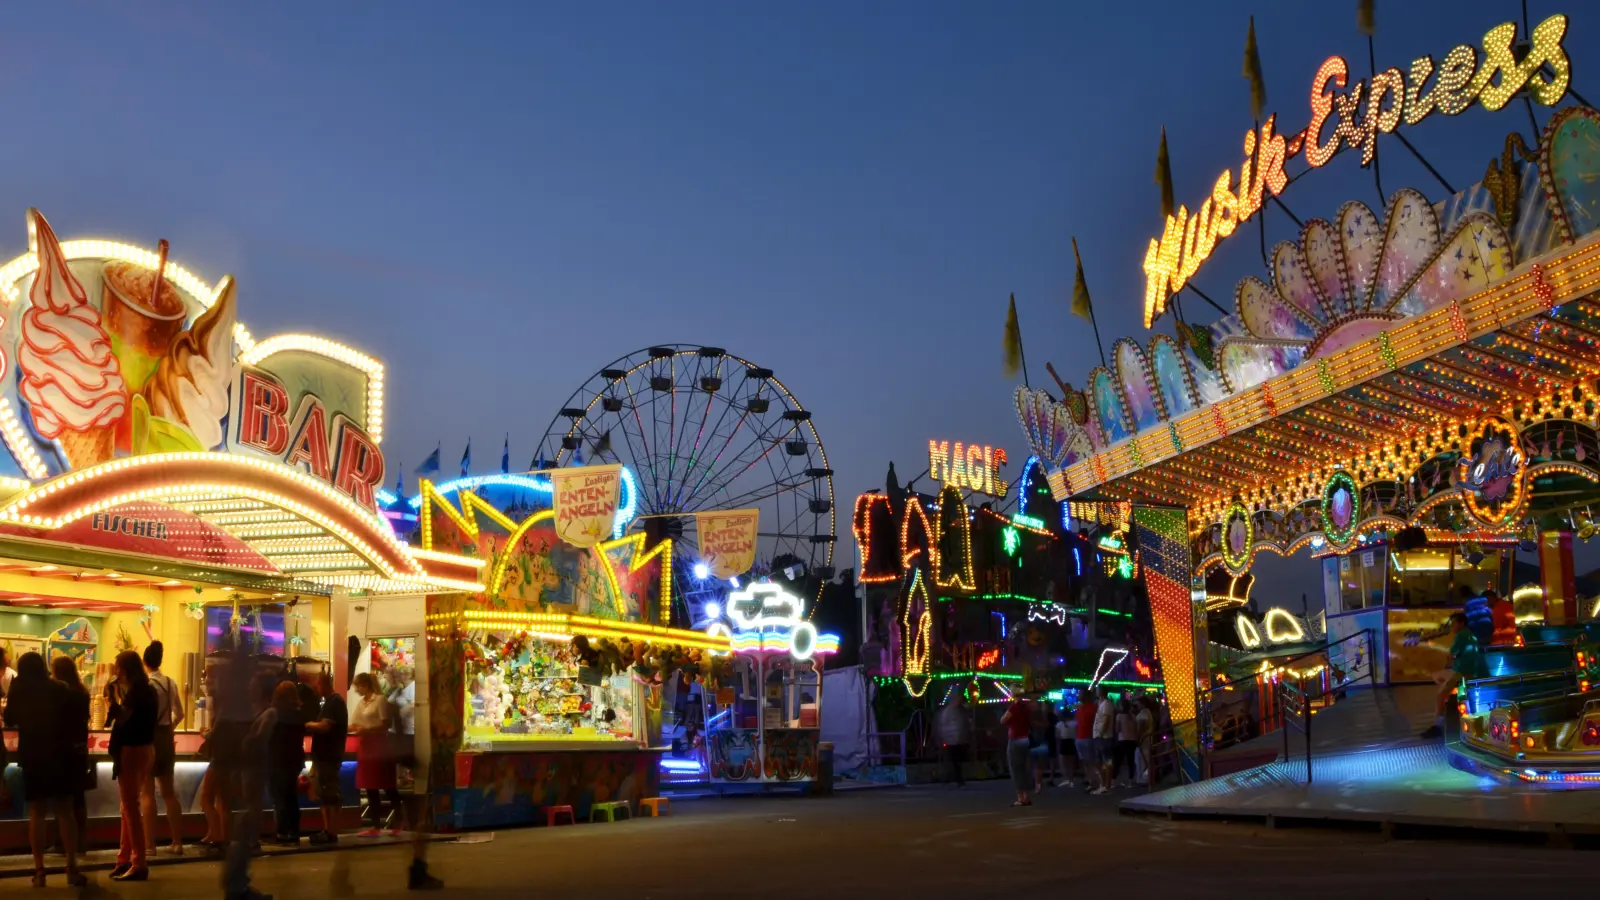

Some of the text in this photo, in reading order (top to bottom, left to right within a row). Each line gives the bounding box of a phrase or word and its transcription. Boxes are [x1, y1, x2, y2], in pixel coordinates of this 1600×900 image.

[237, 371, 383, 515] BAR
[929, 439, 1009, 498] MAGIC
[560, 486, 610, 505] ENTEN-
[558, 500, 615, 522] ANGELN
[92, 512, 168, 540] FISCHER
[703, 540, 752, 557] ANGELN
